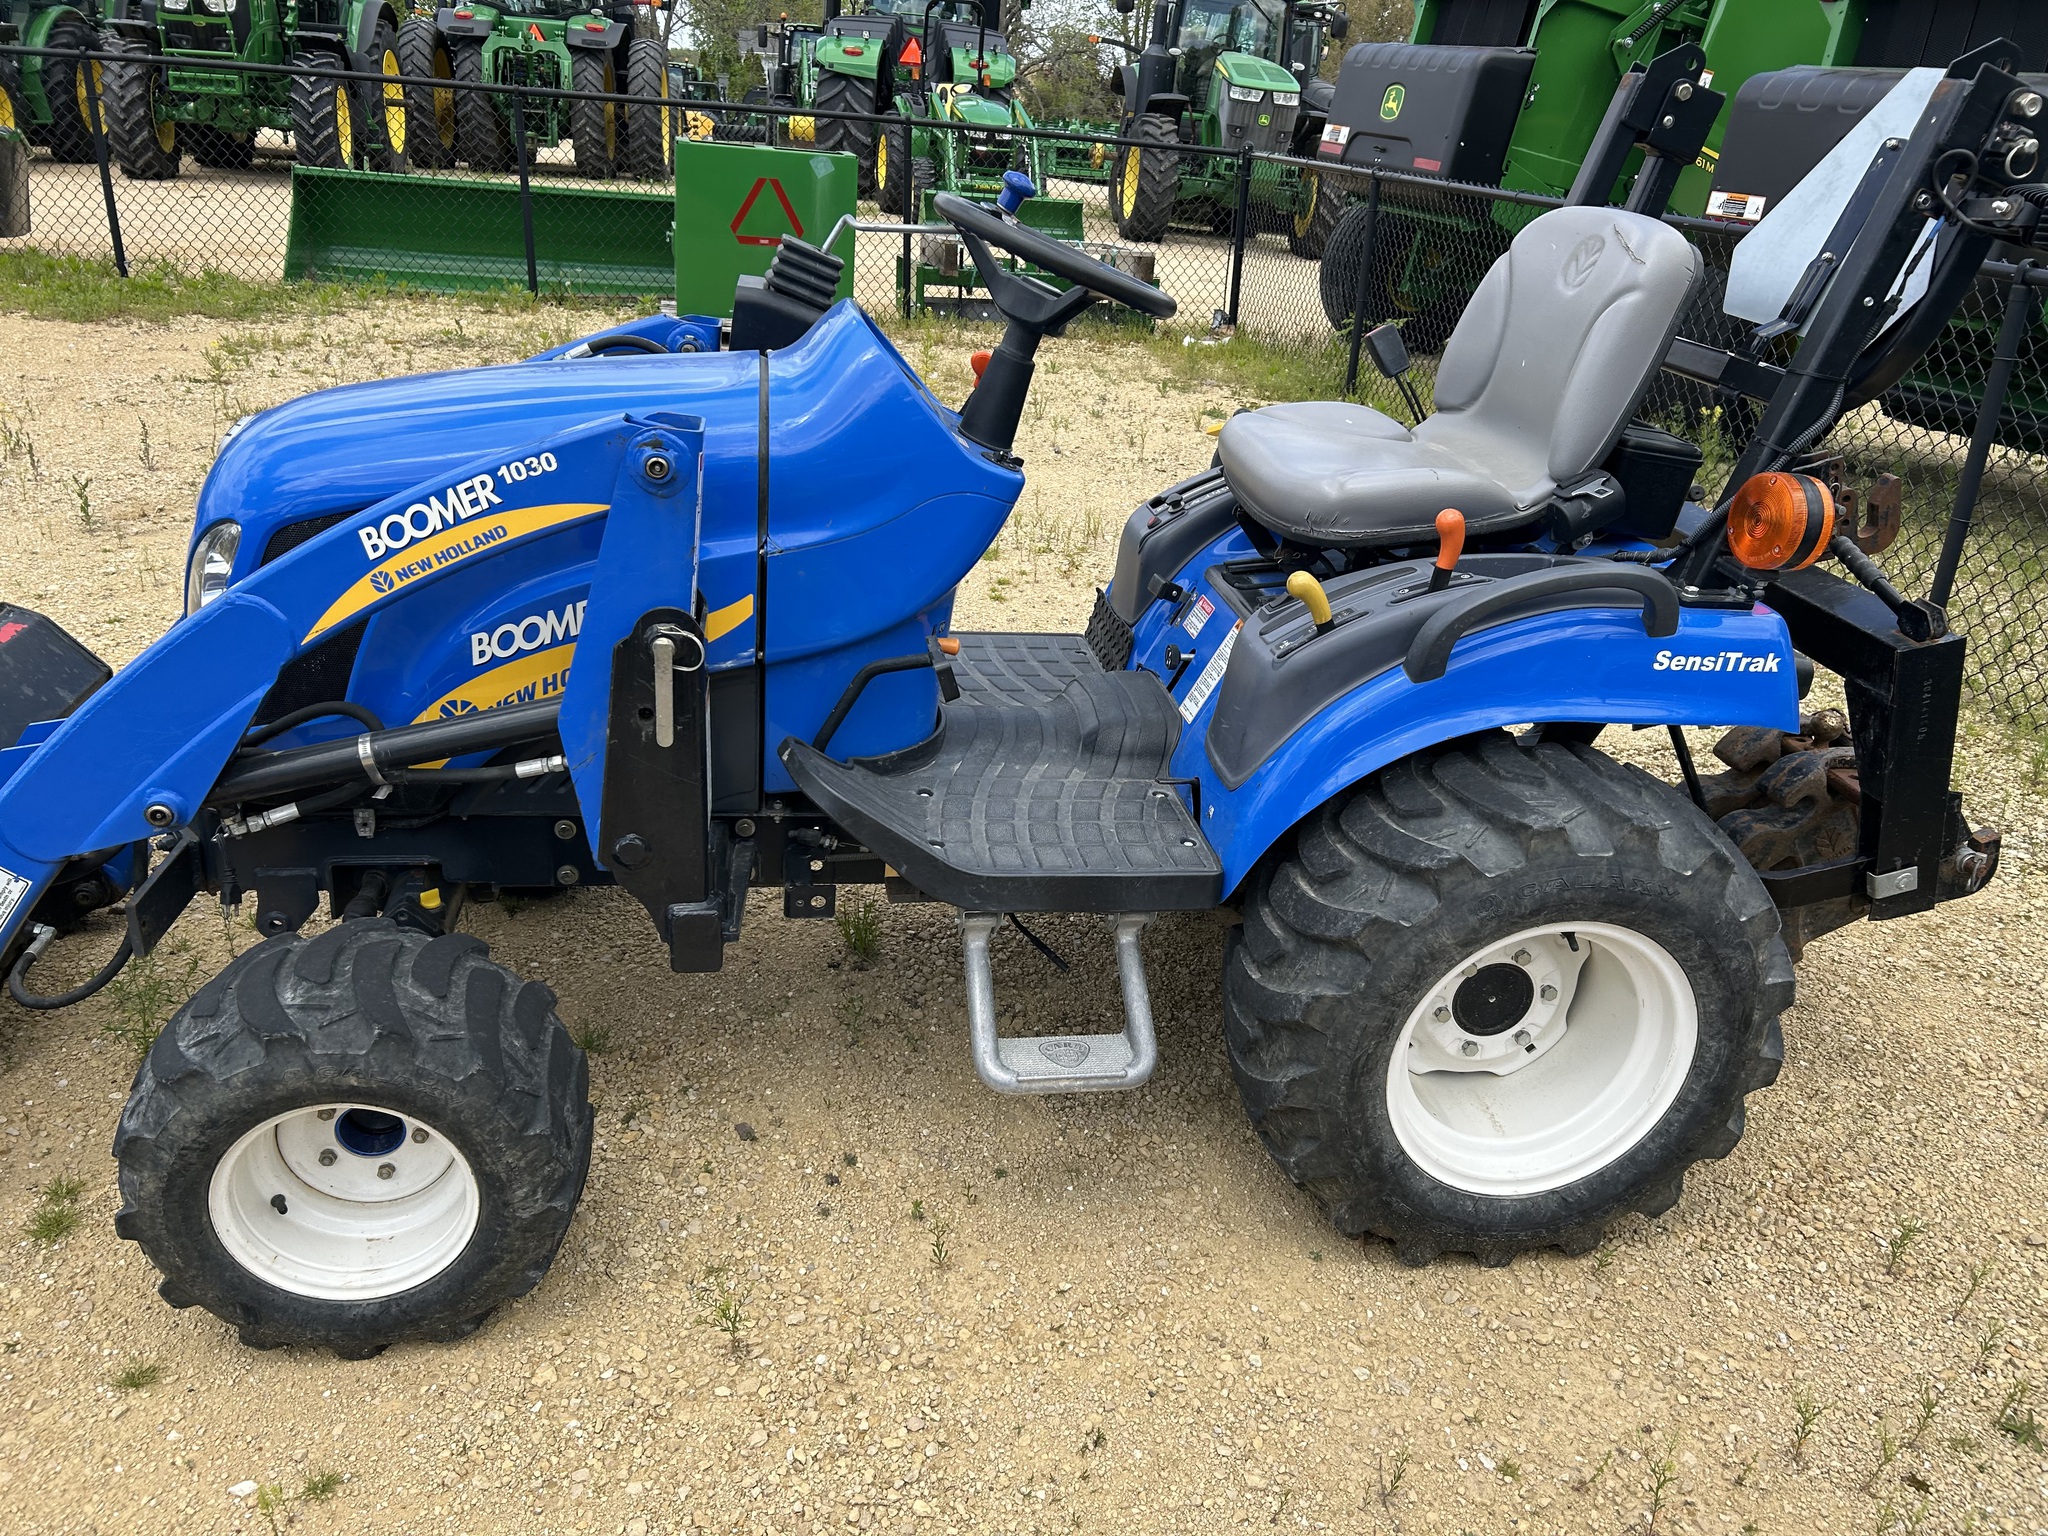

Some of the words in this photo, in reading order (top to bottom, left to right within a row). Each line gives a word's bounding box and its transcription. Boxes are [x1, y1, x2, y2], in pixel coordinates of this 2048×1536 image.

[358, 473, 504, 561] BOOMER
[497, 452, 559, 485] 1030
[394, 556, 434, 582] NEW
[435, 525, 508, 565] HOLLAND
[1653, 650, 1781, 673] SensiTrak
[1516, 874, 1680, 900] GALAXY
